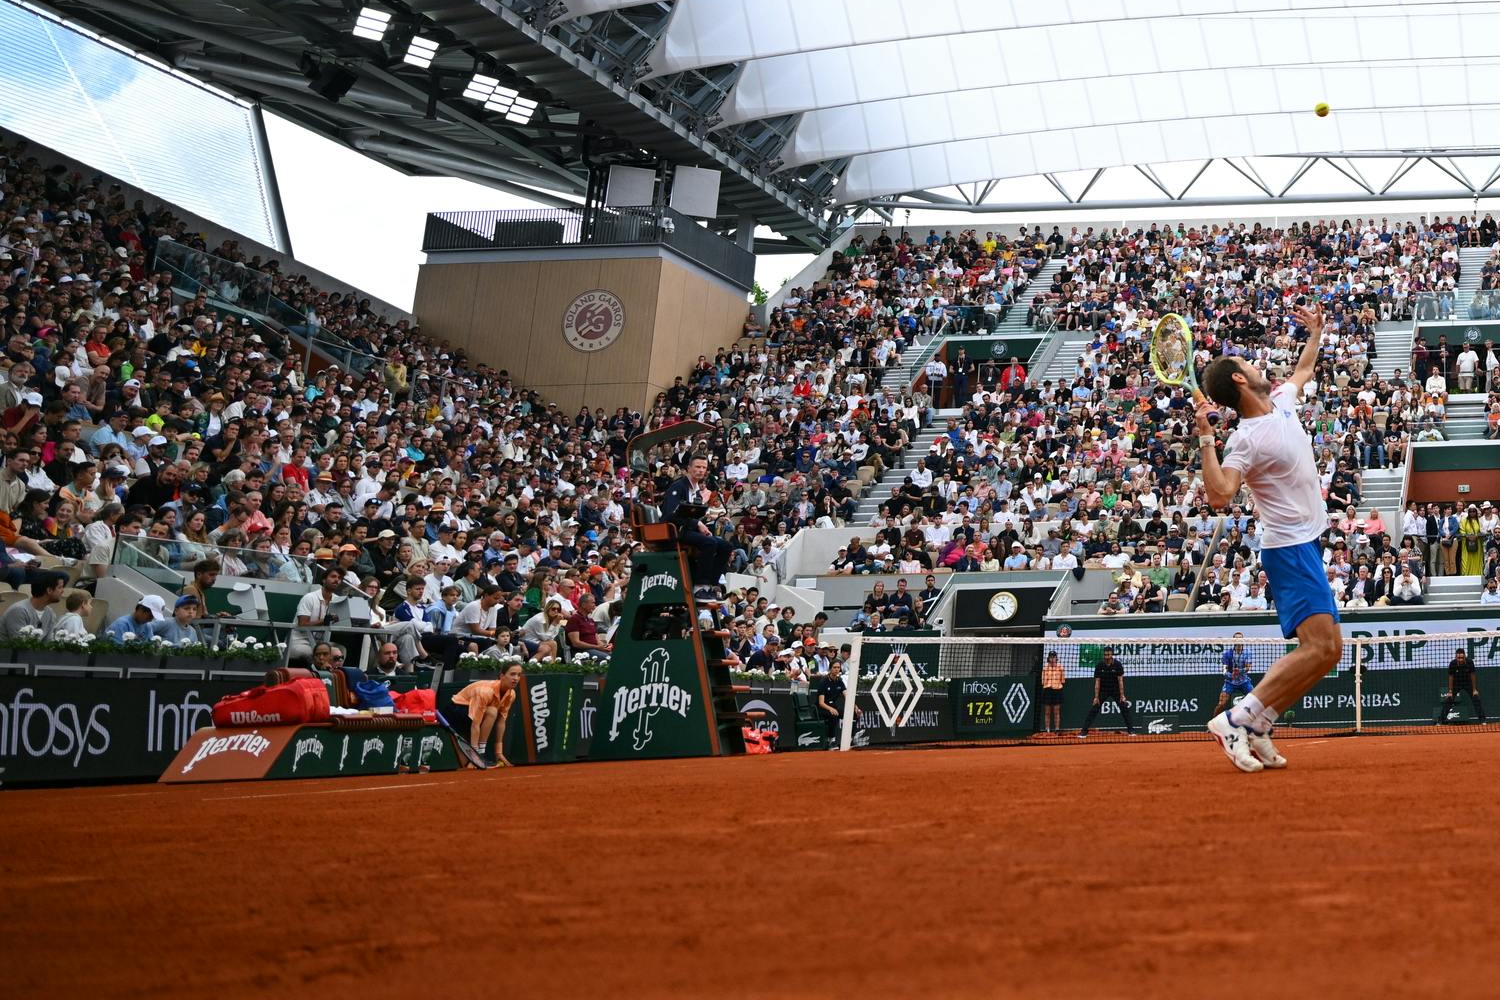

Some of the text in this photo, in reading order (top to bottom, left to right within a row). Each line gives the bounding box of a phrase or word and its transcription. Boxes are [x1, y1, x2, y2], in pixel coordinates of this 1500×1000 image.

[566, 294, 623, 328] ROLAND GARROS
[572, 336, 611, 349] PARIS
[640, 572, 678, 600] perrier
[1351, 630, 1427, 665] BNP
[962, 681, 997, 695] Infosys
[609, 676, 692, 742] perrier
[967, 702, 993, 716] 172
[1136, 698, 1198, 714] PARIBAS
[1303, 692, 1401, 709] BNP PARIBAS
[230, 711, 281, 724] Wilson
[530, 681, 550, 752] Wilson
[975, 716, 993, 725] km/h
[181, 730, 270, 774] perrier
[293, 734, 324, 773] perrier
